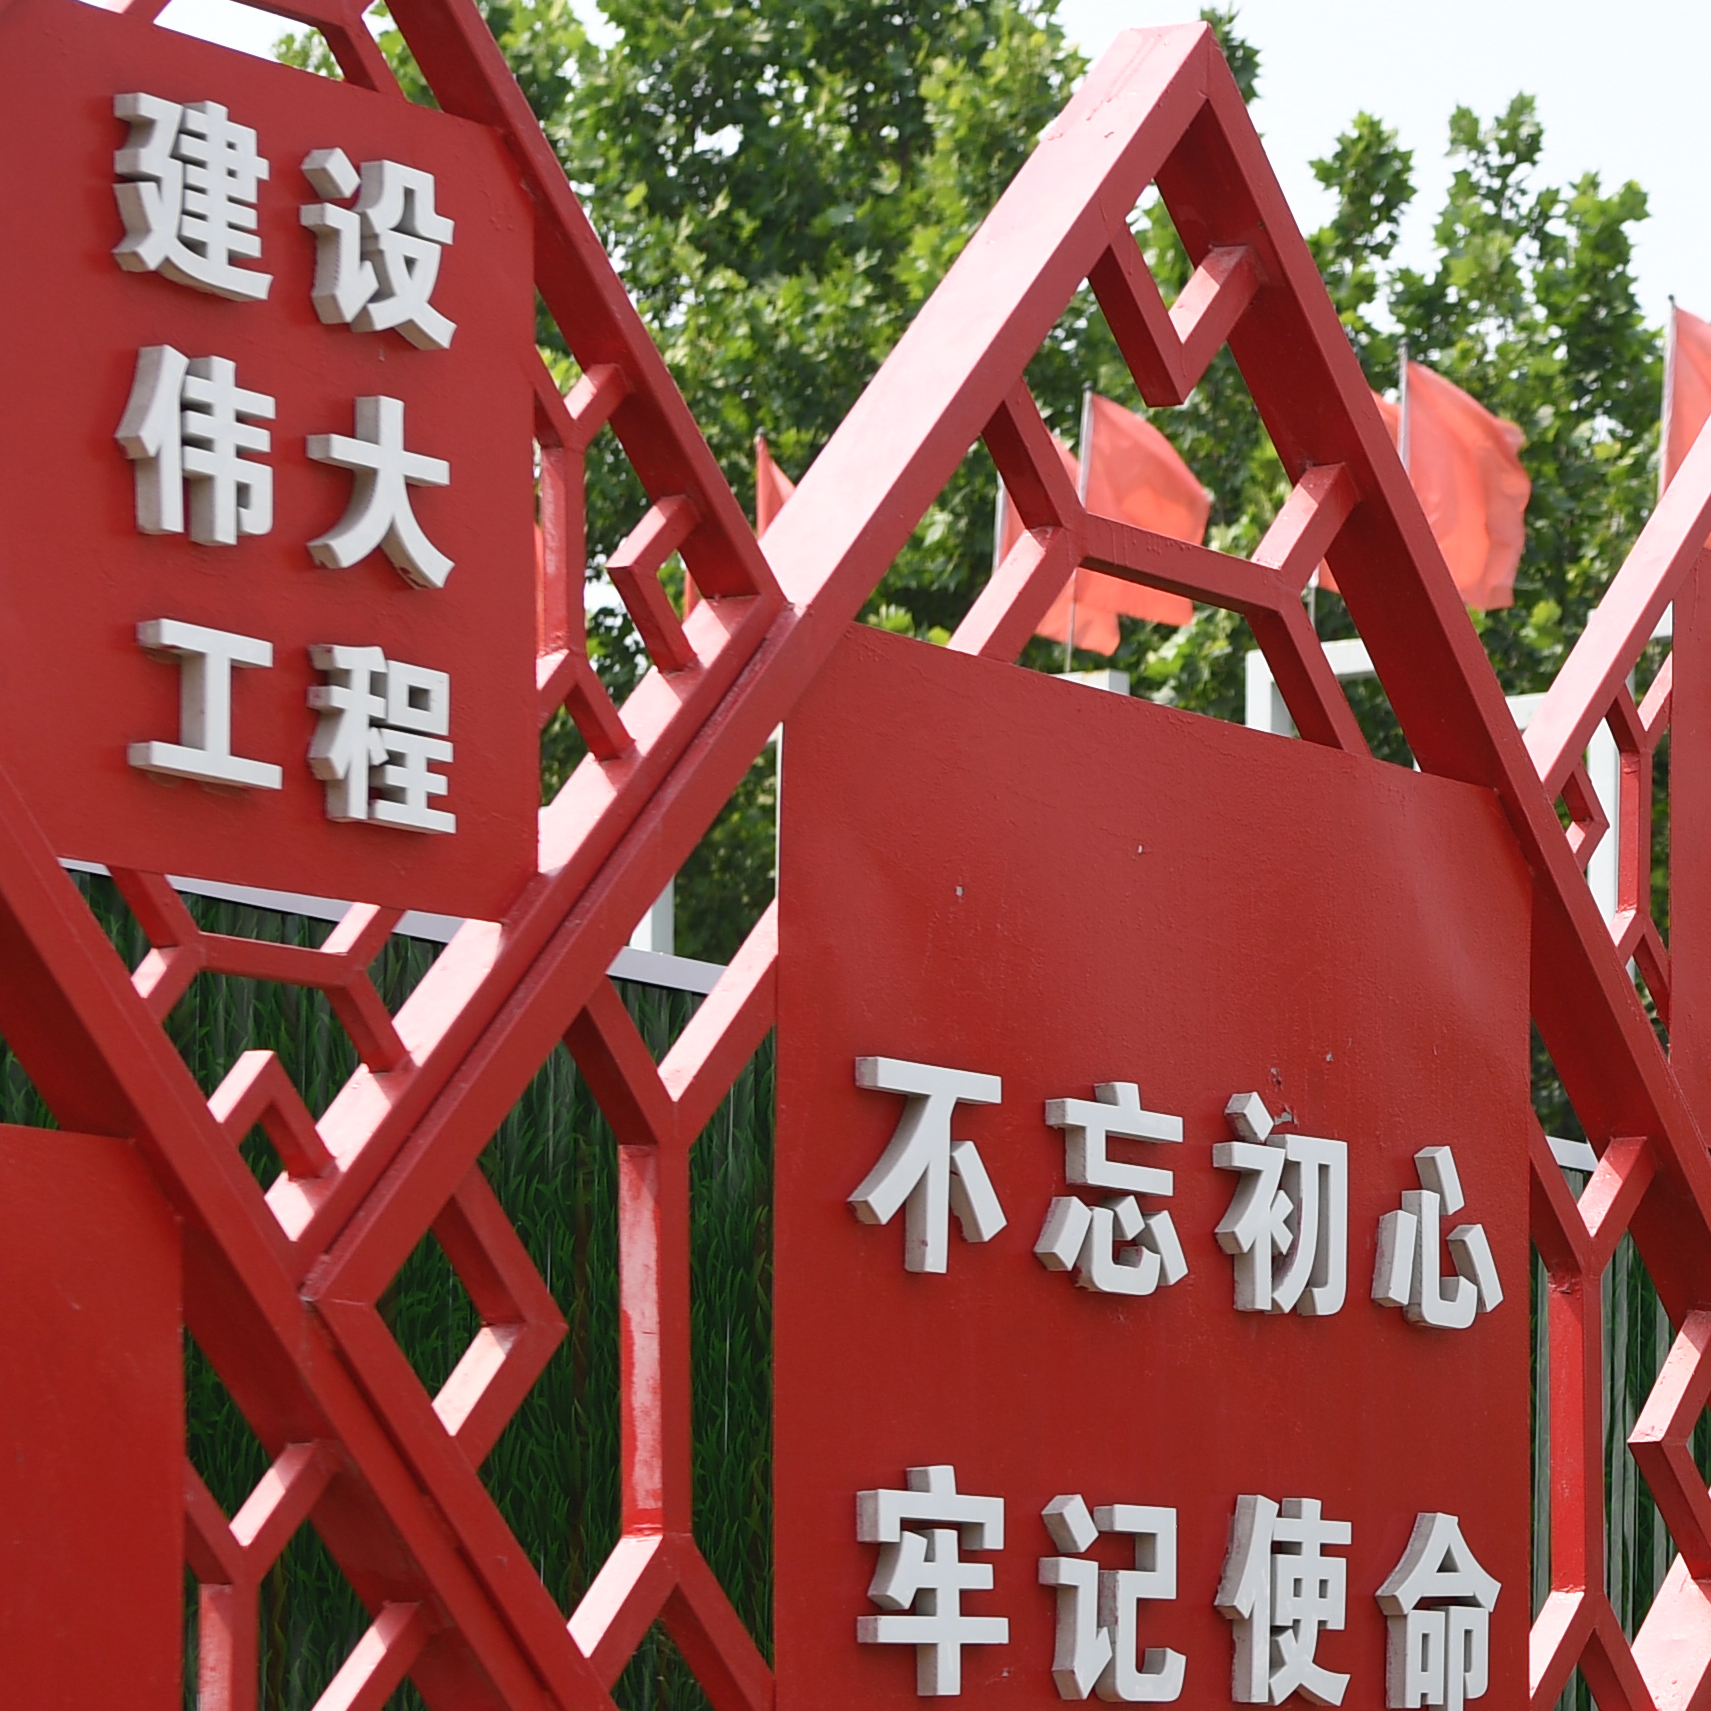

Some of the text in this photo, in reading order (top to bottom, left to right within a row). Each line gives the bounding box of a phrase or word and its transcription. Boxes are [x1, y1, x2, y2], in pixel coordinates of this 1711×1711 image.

[113, 91, 457, 350] 建设
[115, 344, 456, 589] 伟大
[127, 618, 457, 834] 工程
[847, 1056, 1504, 1329] 不忘初心
